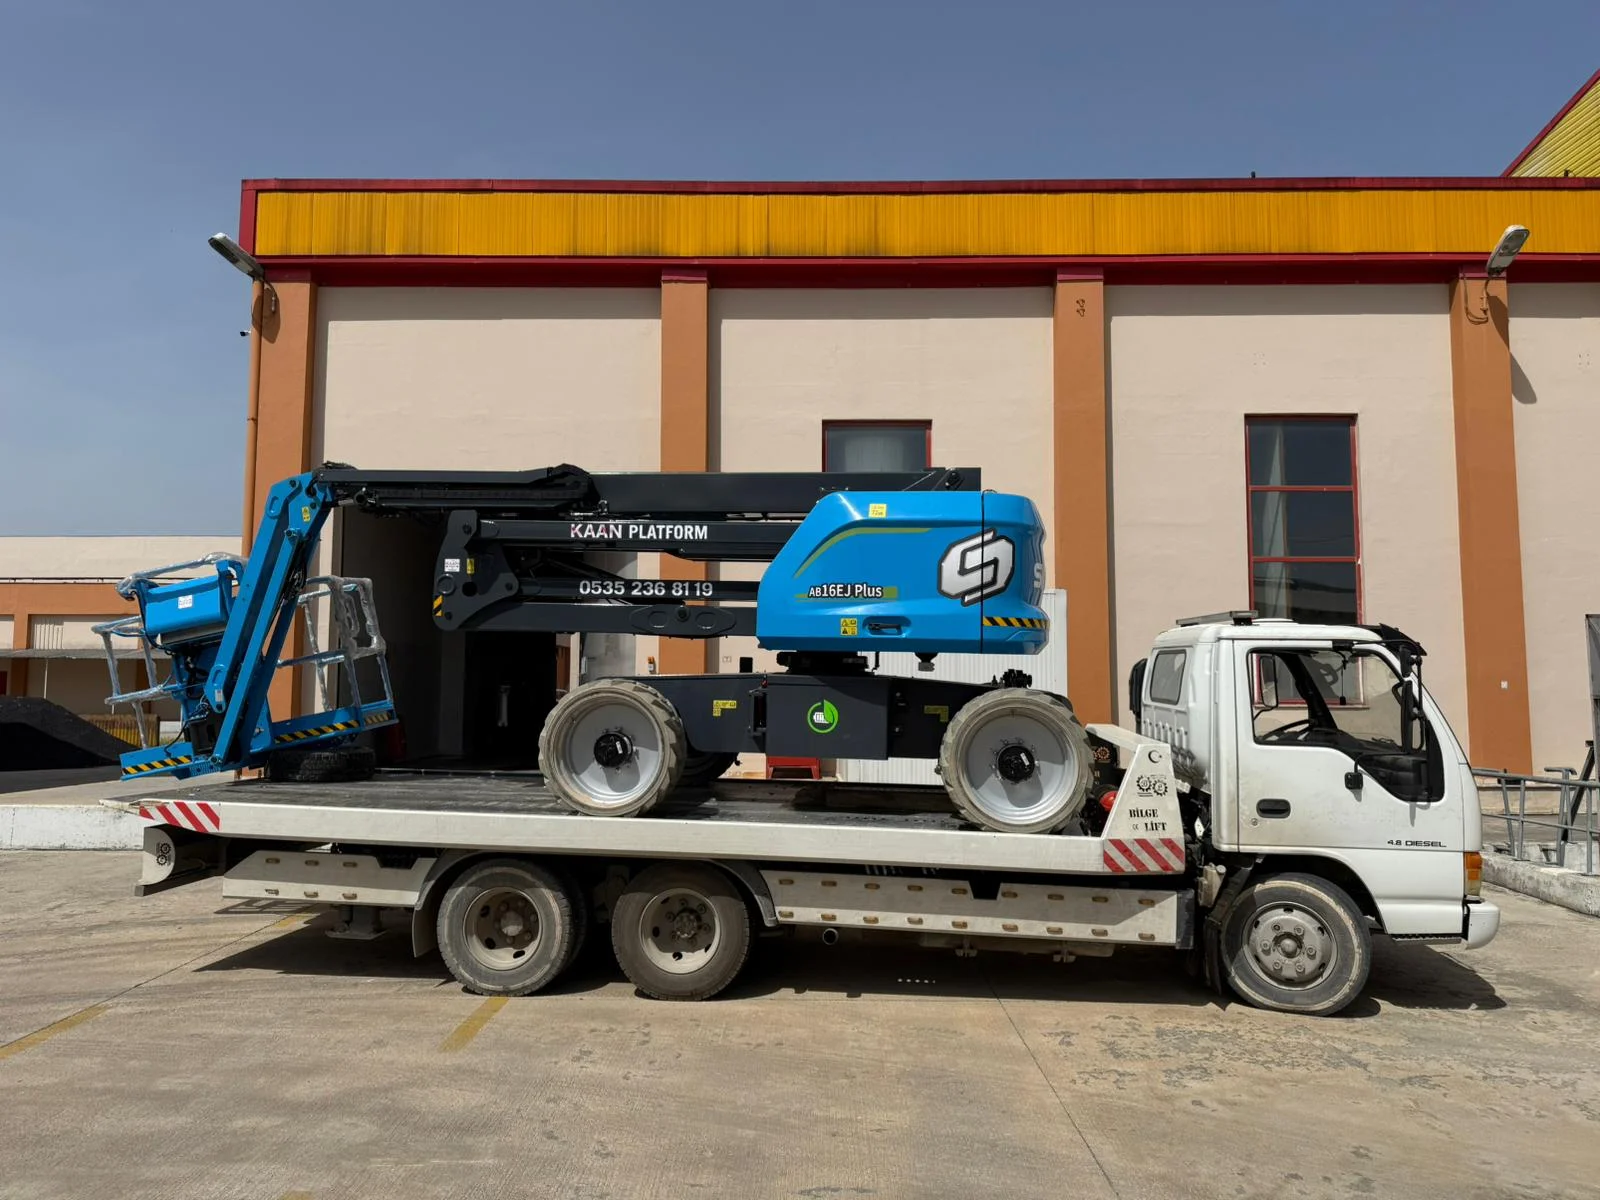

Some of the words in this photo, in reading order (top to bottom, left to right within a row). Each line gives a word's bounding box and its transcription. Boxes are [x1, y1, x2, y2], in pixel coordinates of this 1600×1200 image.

[570, 523, 622, 538] KAAN
[629, 525, 708, 539] PLATFORM
[579, 580, 625, 595] 0535
[631, 581, 666, 596] 236
[808, 583, 851, 597] AB16EJ
[854, 583, 882, 597] Plus
[1405, 840, 1447, 848] DIESEL
